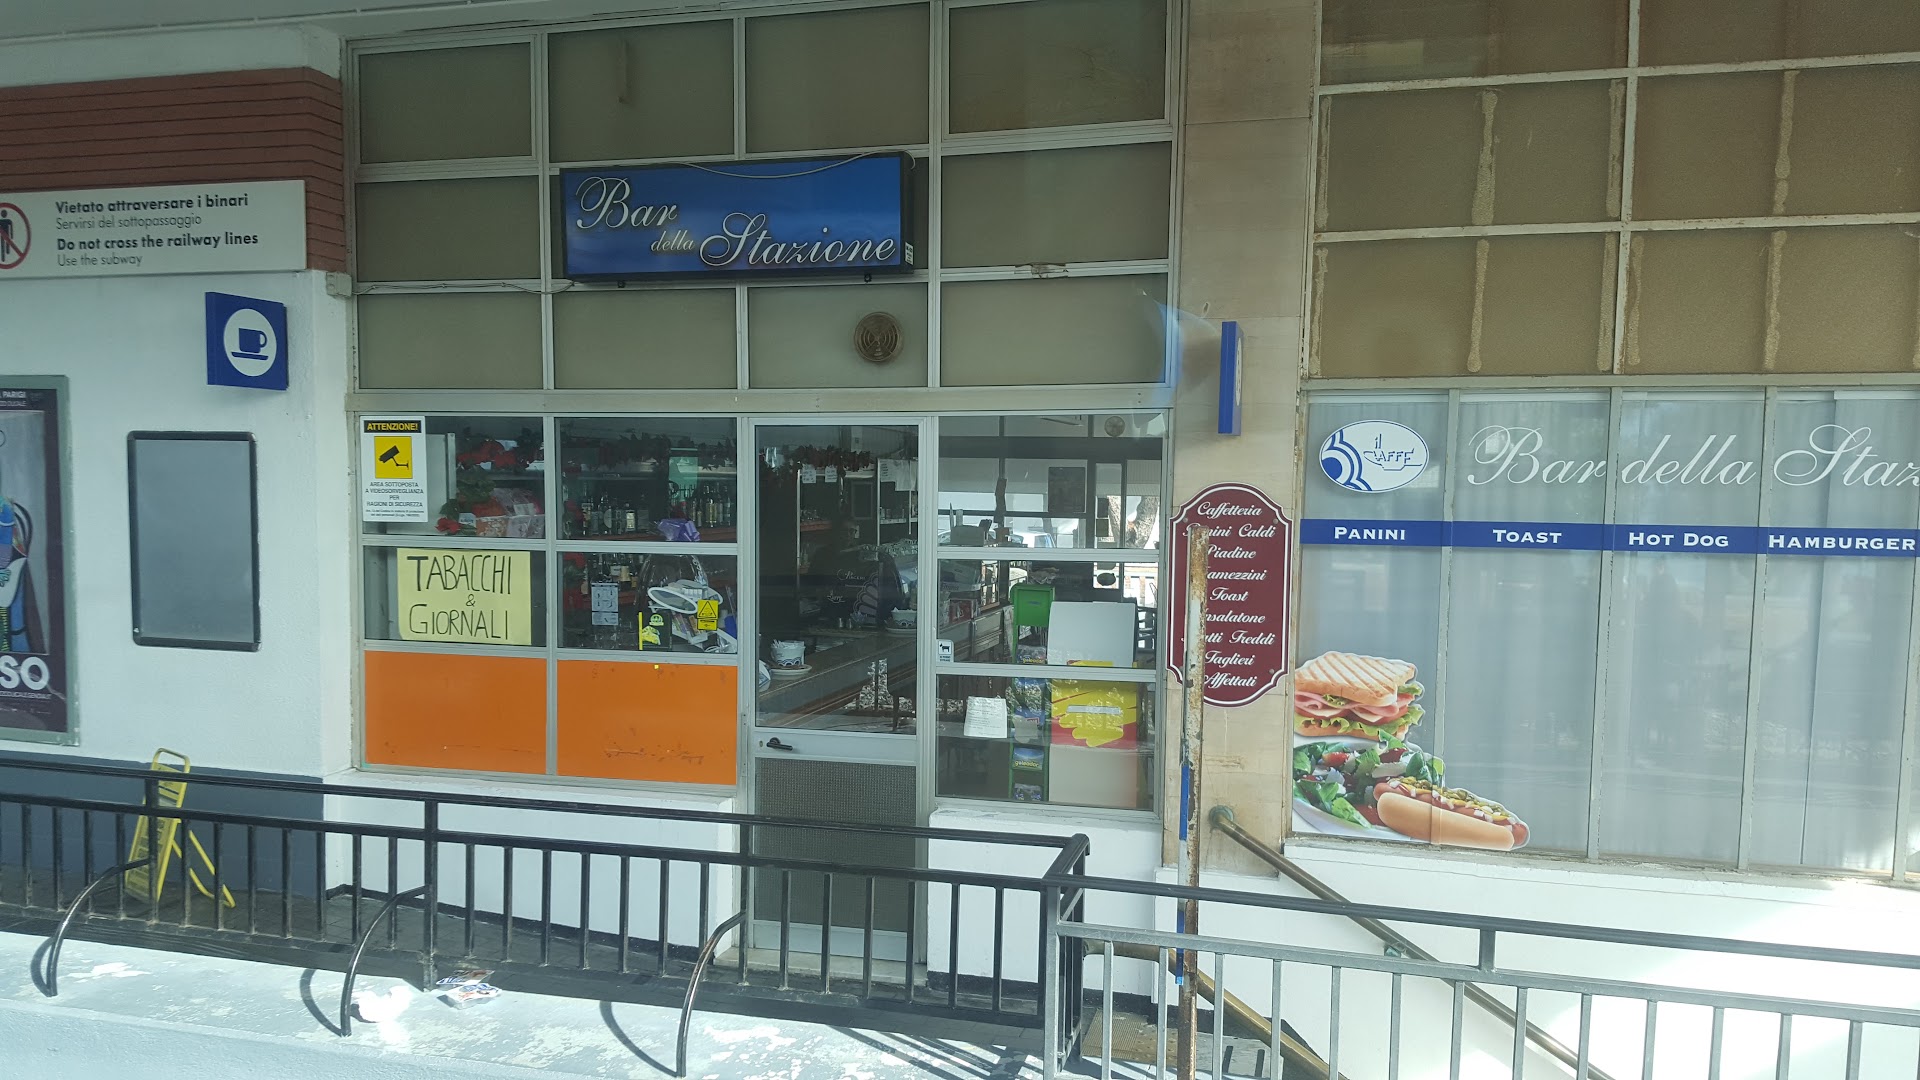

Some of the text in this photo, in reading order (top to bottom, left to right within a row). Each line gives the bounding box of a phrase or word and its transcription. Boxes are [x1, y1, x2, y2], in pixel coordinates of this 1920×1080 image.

[55, 193, 249, 214] Vietato attraversare i binari
[576, 175, 678, 229] Bar
[56, 212, 202, 230] Servirsi del sottopassaggio
[57, 231, 259, 251] Do not cross the railway lines
[650, 230, 696, 253] della
[699, 211, 897, 267] Stazione
[57, 250, 143, 267] Use the subway
[367, 422, 419, 431] ATTENZIONE!
[1467, 424, 1607, 486] Bar
[1620, 433, 1757, 486] della
[1197, 501, 1263, 520] Caffetteria
[1238, 523, 1277, 538] Caldi
[1334, 525, 1407, 541] PANINI
[1492, 528, 1563, 545] TOAST
[1628, 531, 1730, 548] HOT DOG
[1768, 534, 1917, 552] HAMBURGER
[406, 554, 512, 595] TABACCHI
[465, 593, 476, 608] &
[1209, 586, 1249, 602] Toast
[409, 603, 509, 641] GIORNALI
[1228, 629, 1276, 646] Freddi
[1204, 649, 1256, 669] Taglieri
[1203, 671, 1258, 689] Affettati
